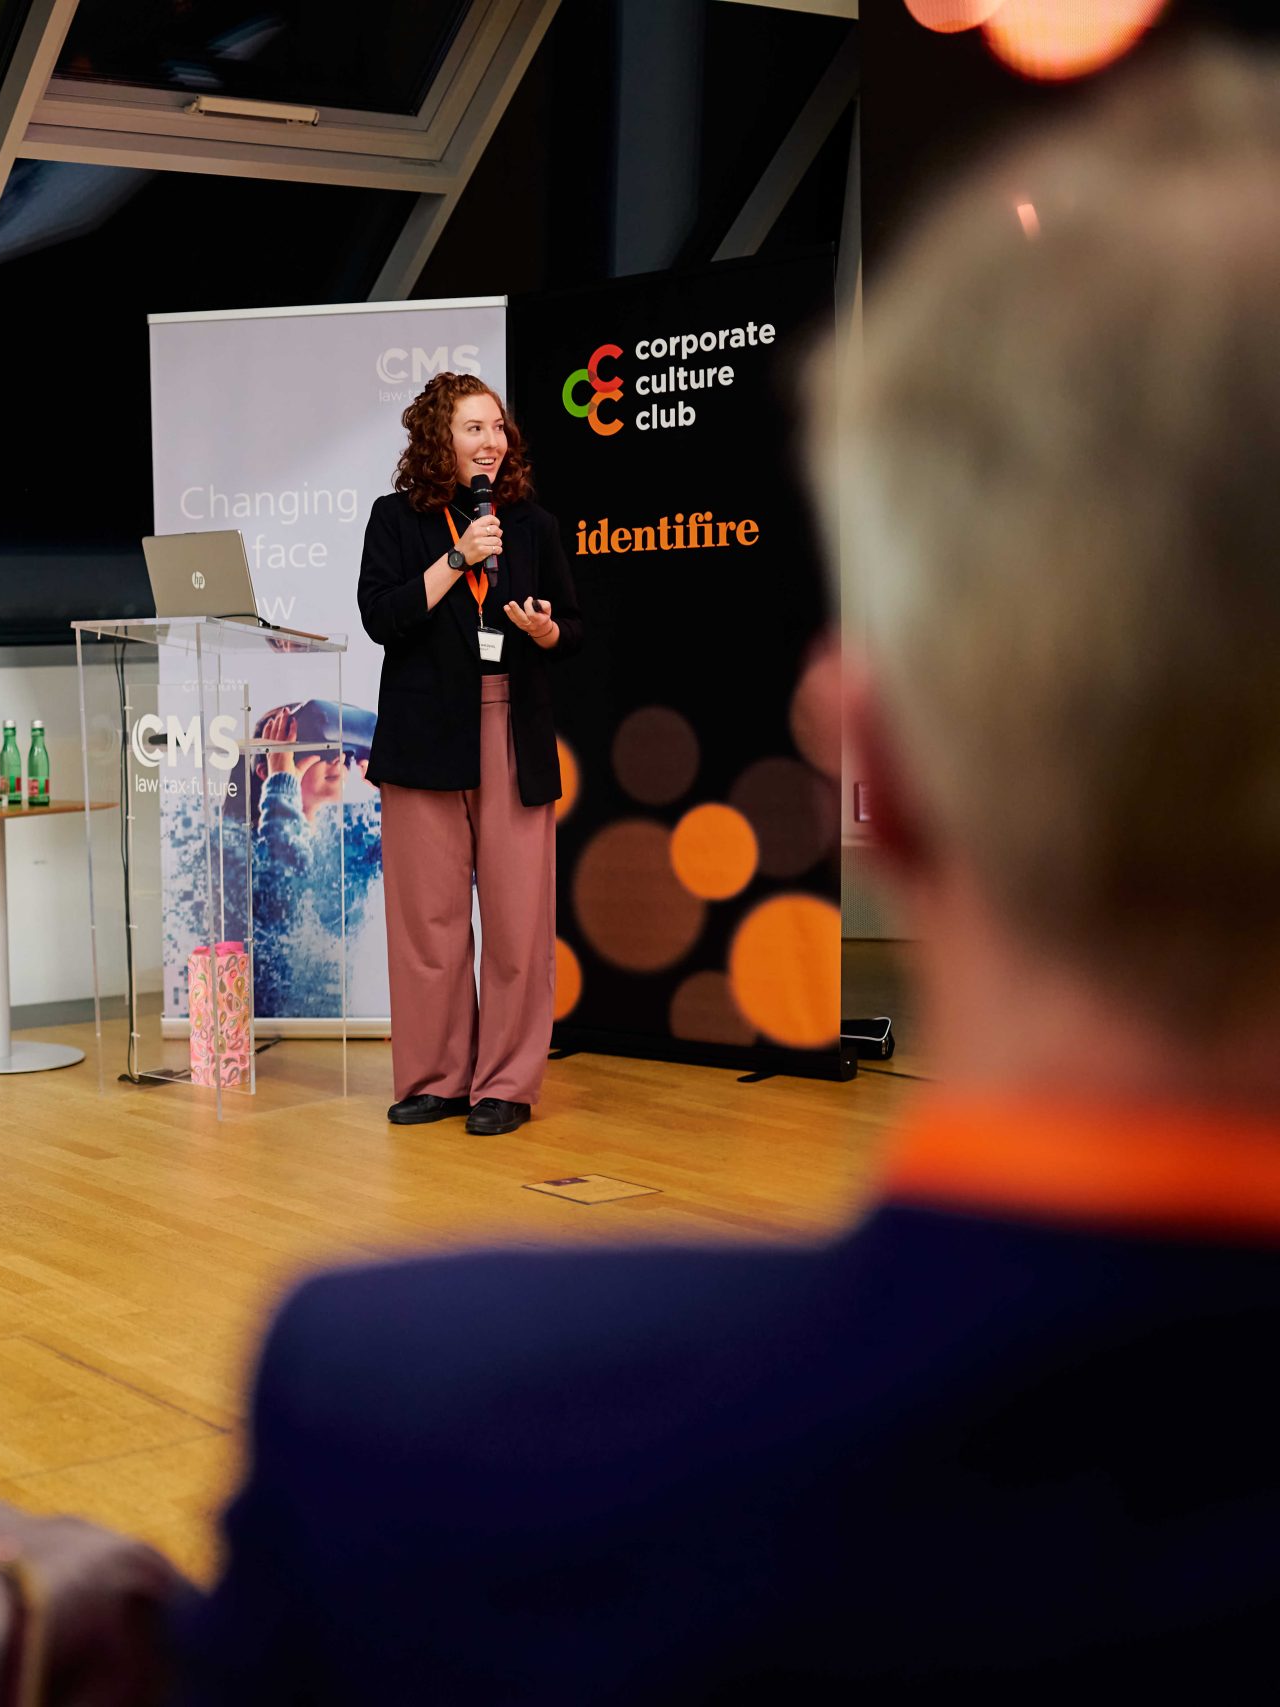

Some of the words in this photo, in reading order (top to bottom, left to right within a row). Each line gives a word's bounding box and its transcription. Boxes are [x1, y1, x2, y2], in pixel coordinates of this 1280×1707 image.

[635, 321, 776, 360] corporate
[376, 344, 482, 384] CMS
[635, 365, 735, 396] culture
[635, 400, 696, 431] club
[179, 481, 359, 525] Changing
[250, 534, 329, 569] face
[575, 511, 760, 555] identifire
[132, 714, 239, 770] CMS
